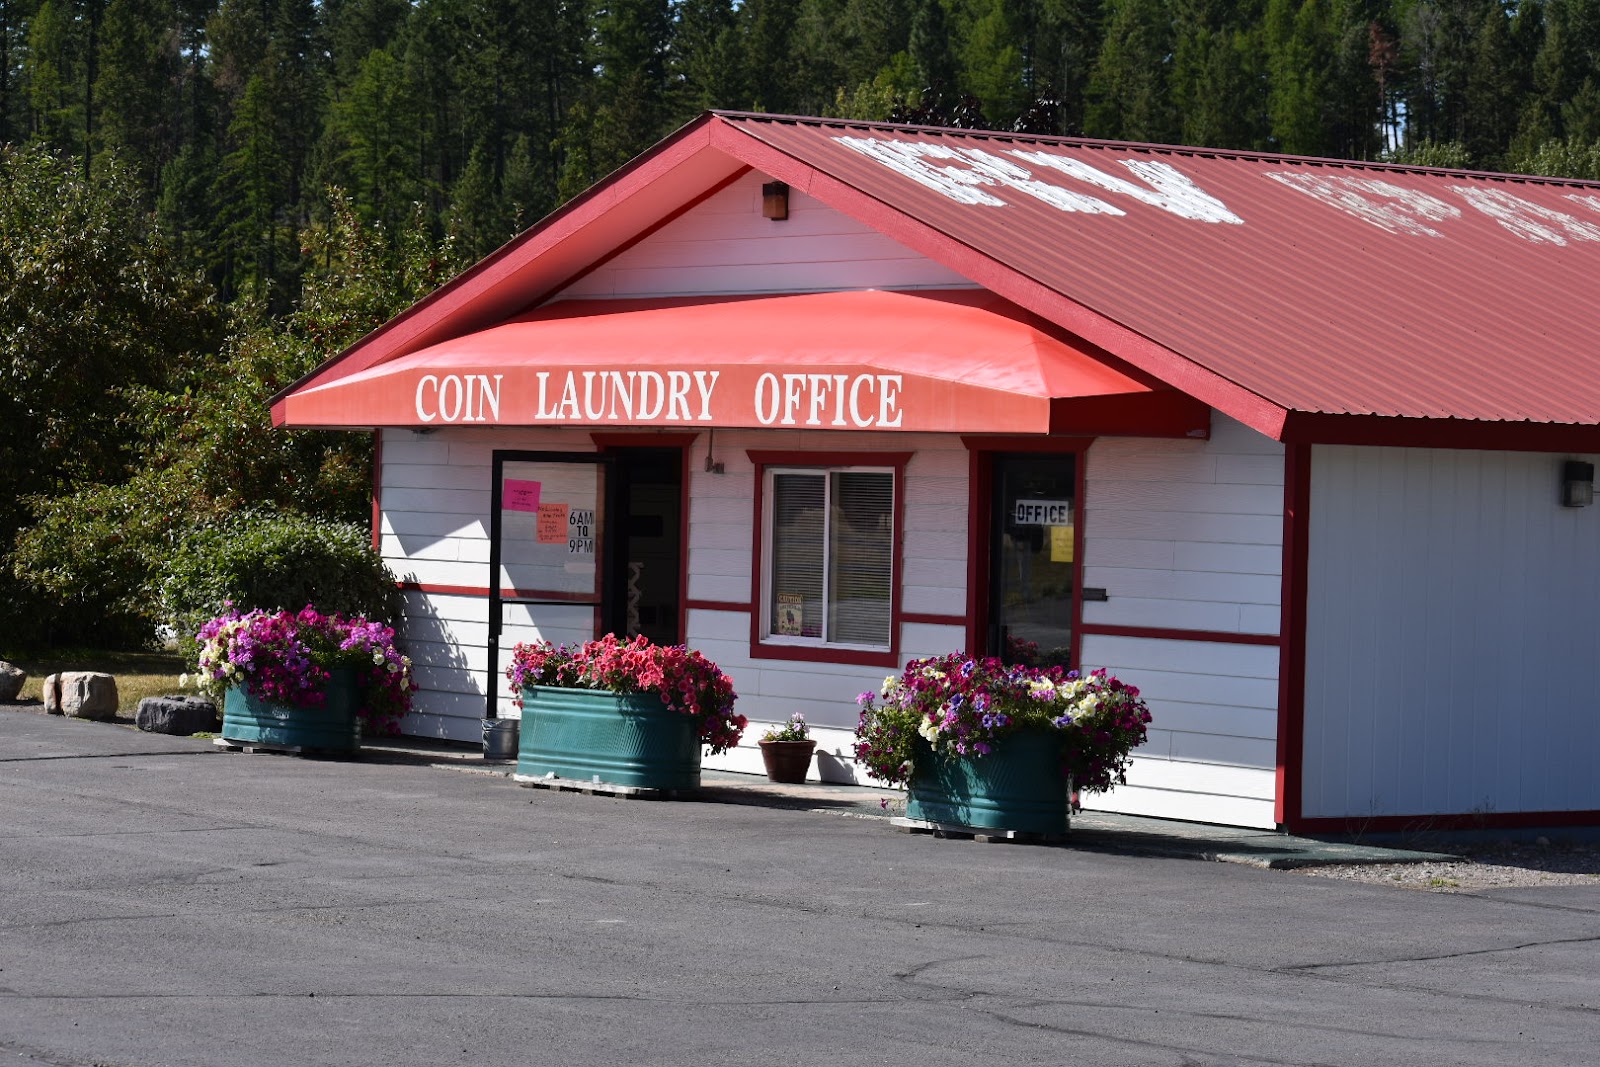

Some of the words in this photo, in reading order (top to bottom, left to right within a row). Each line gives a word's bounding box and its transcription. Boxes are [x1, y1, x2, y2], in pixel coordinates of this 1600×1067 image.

[830, 135, 1245, 225] RV
[415, 374, 503, 422] COIN
[535, 371, 719, 422] LAUNDRY
[754, 372, 903, 428] OFFICE
[569, 511, 593, 525] 6AM
[1017, 503, 1066, 523] OFFICE
[577, 525, 588, 537] TO
[569, 540, 593, 553] 9PM
